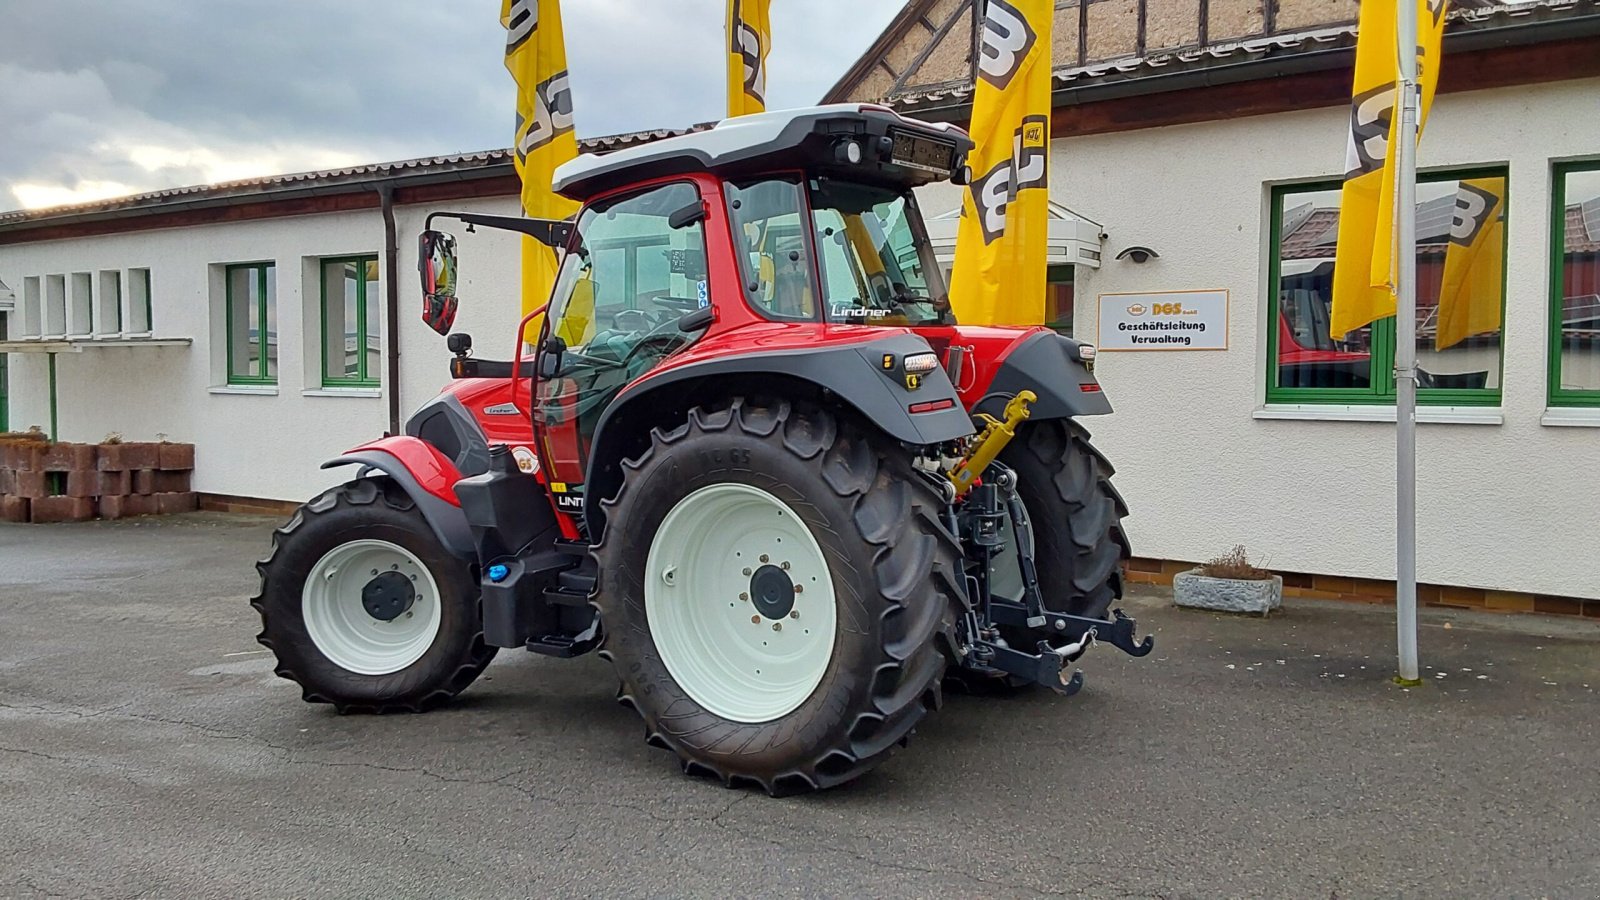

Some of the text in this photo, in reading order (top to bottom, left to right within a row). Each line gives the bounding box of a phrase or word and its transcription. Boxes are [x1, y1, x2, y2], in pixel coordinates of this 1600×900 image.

[831, 304, 891, 317] Lindner
[1152, 303, 1182, 315] DGS
[1118, 321, 1206, 332] Geschäftsleitung
[1131, 335, 1191, 345] Verwaltung
